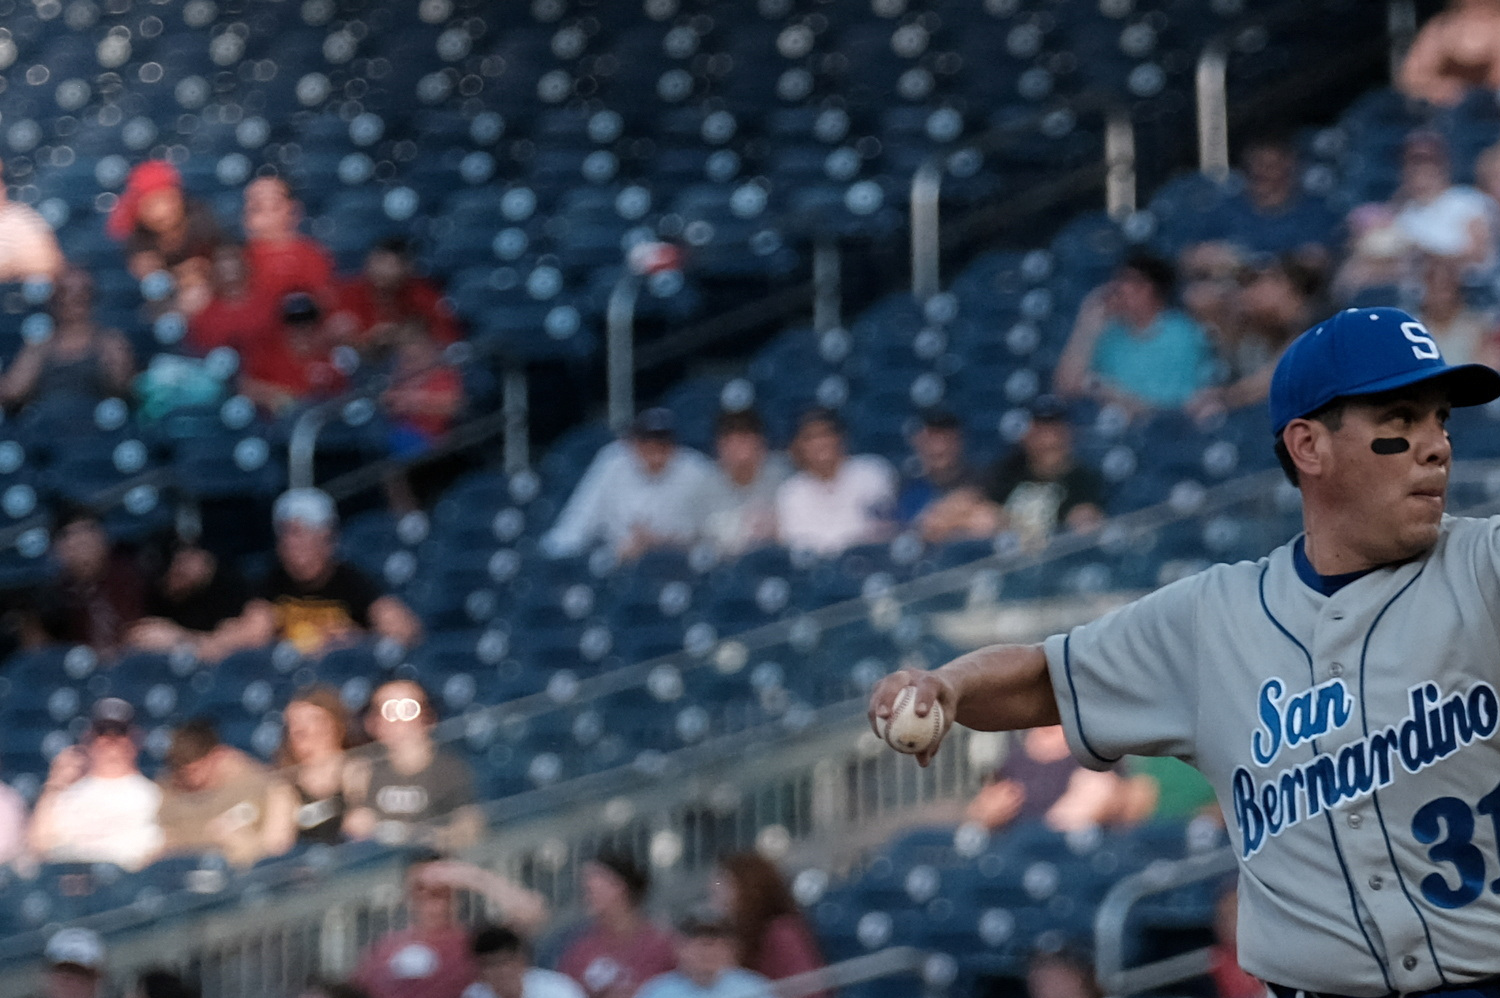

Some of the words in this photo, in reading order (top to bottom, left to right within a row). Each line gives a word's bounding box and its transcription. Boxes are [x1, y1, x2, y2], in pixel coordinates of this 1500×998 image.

[1400, 321, 1440, 360] S
[1251, 677, 1354, 767] San
[1232, 680, 1500, 861] Bernardino
